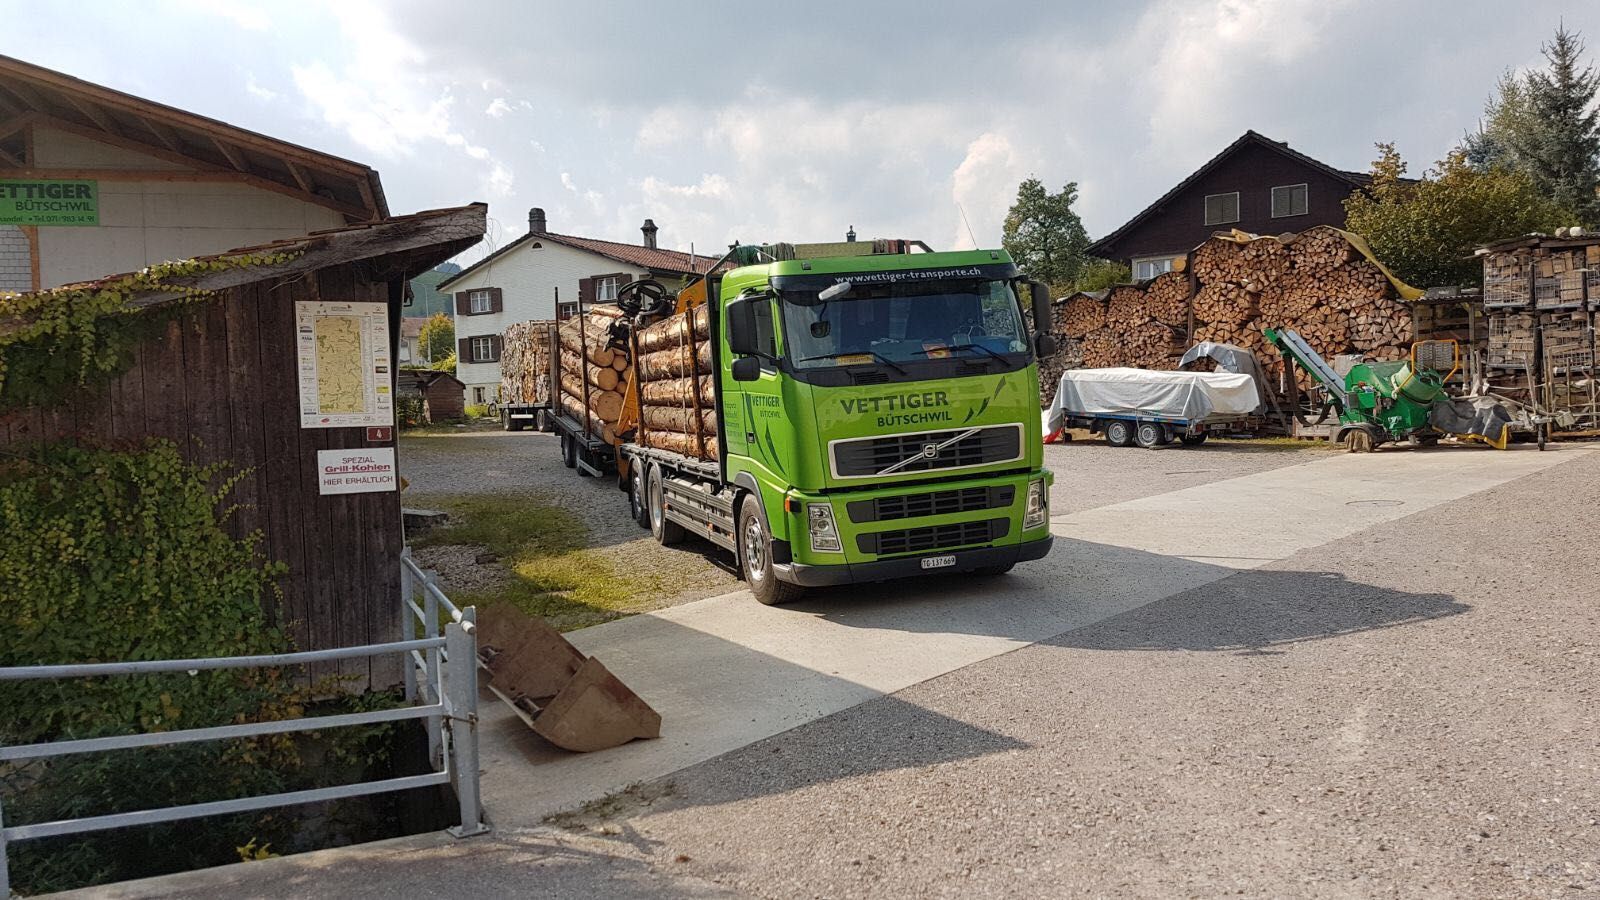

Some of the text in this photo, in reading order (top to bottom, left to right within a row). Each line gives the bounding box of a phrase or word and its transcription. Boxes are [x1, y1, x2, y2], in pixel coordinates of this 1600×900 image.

[16, 199, 95, 211] BÜTSCHWIL
[835, 267, 981, 283] www.vettiger-transporte.ch
[751, 395, 780, 407] VETTIGER
[840, 391, 949, 415] VETTIGER
[877, 411, 953, 428] BÜTSCHWIL
[342, 456, 375, 464] SPEZIAL
[325, 464, 391, 473] Grill-Kohlen
[323, 475, 393, 486] HIER ERHÄLTLICH
